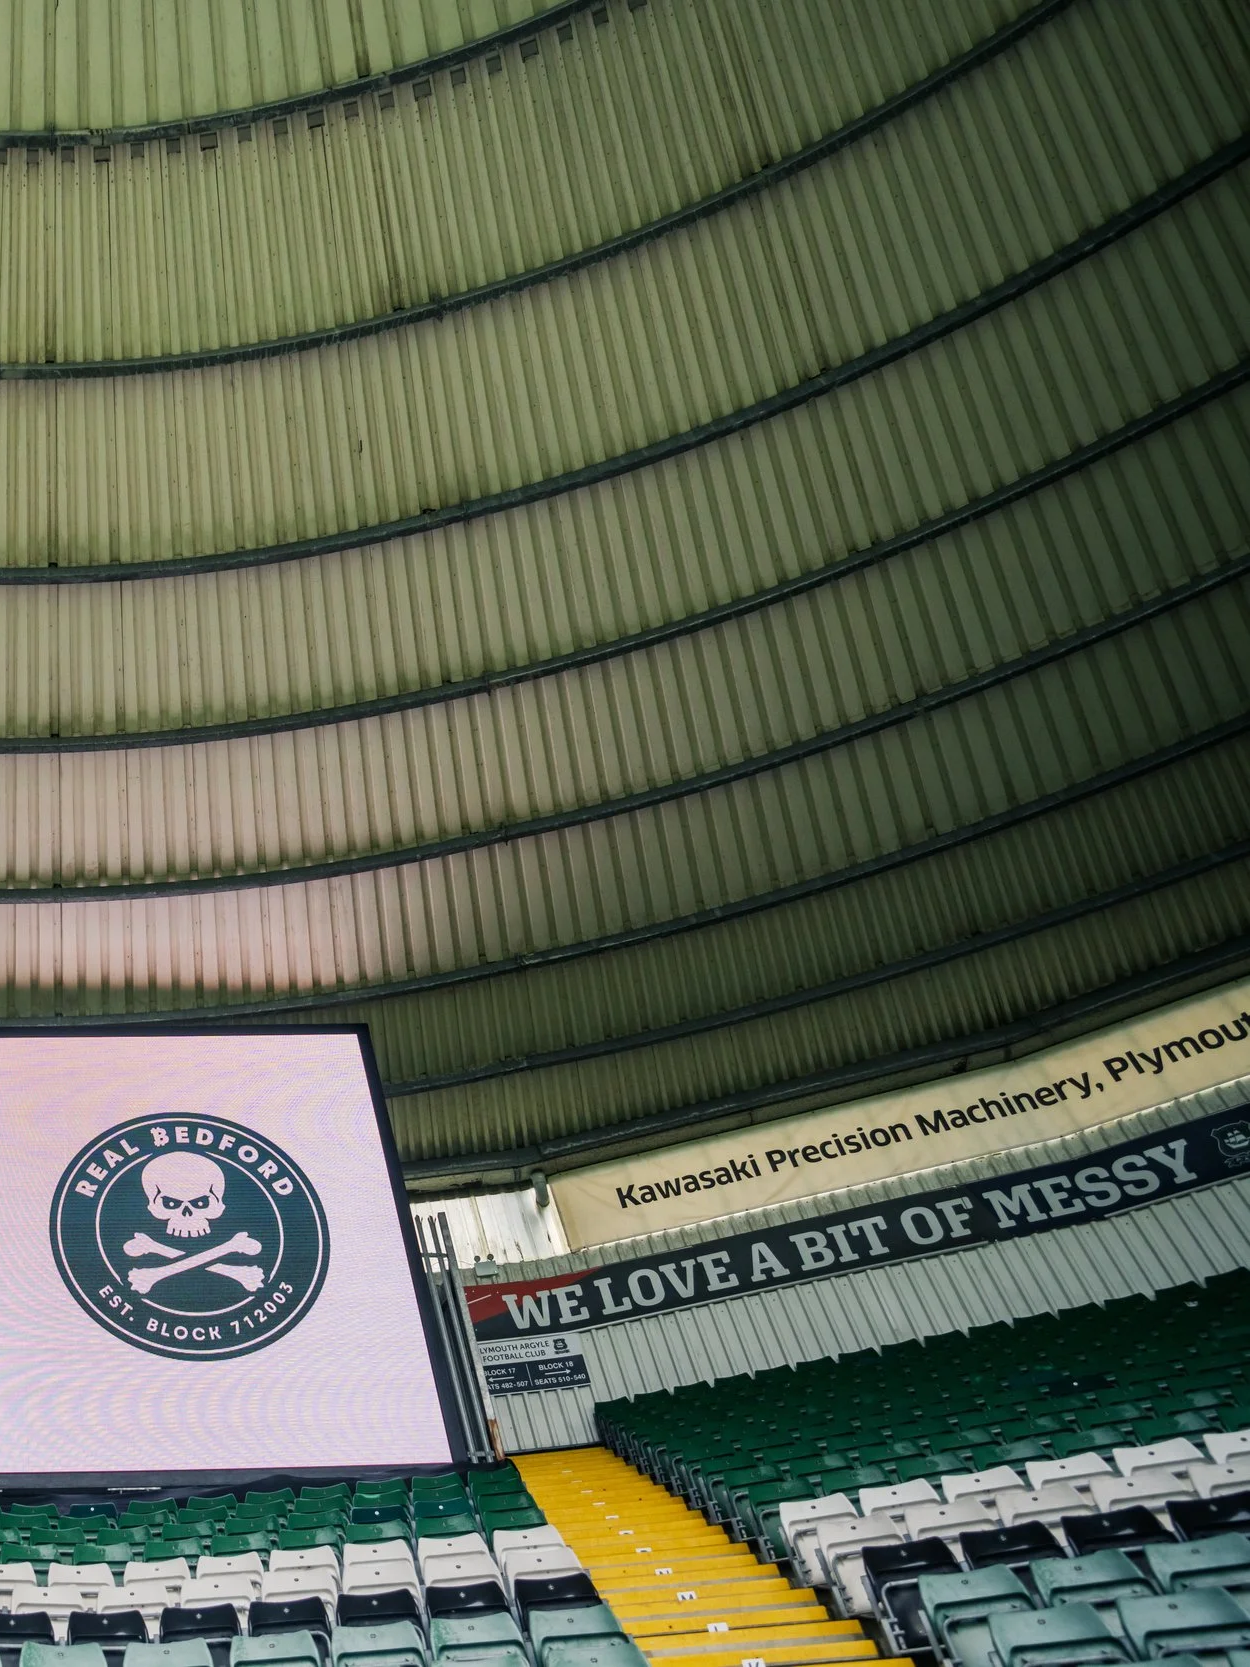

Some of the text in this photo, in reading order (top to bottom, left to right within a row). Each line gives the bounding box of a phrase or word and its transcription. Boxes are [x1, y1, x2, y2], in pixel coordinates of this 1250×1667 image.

[616, 1154, 762, 1208] Kawasaki
[765, 1122, 913, 1173] Precision
[914, 1072, 1104, 1136] Machinery,
[75, 1138, 140, 1198] REAL
[502, 1138, 1198, 1330] WE LOVE A BIT OF MESSY
[98, 1281, 294, 1340] EST. BLOCK 712003
[480, 1340, 550, 1354] LYMOUTH ARGYLE
[483, 1352, 524, 1362] FOOTBALL
[525, 1349, 546, 1358] CLUB
[538, 1362, 564, 1371] BLOCK
[501, 1380, 528, 1388] 482-507
[534, 1377, 557, 1386] SEATS
